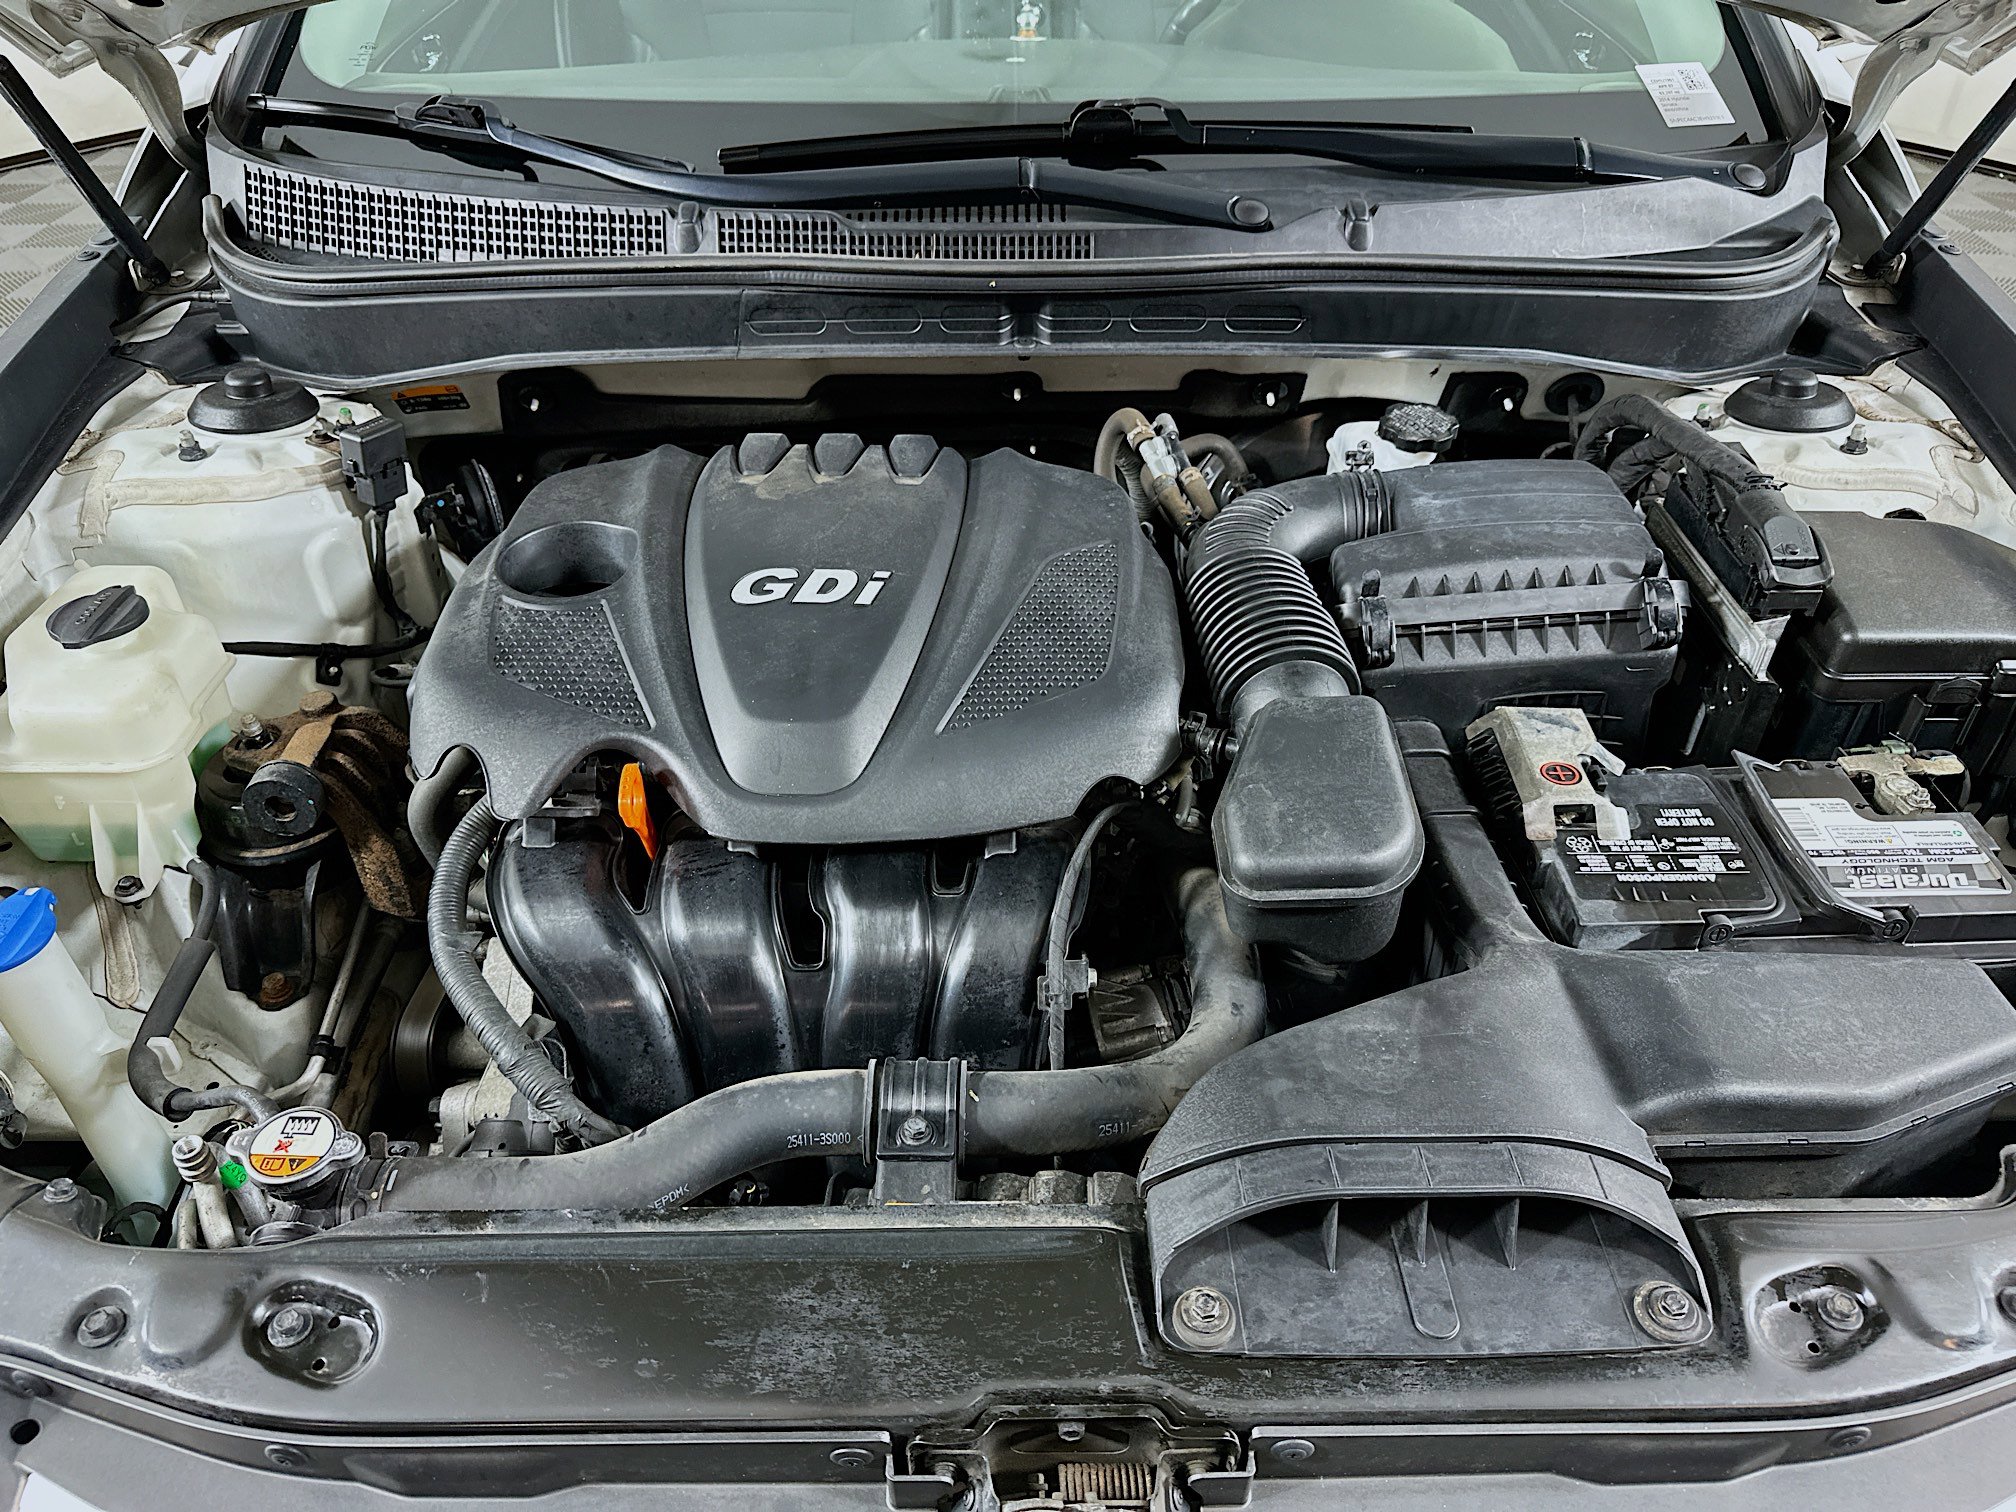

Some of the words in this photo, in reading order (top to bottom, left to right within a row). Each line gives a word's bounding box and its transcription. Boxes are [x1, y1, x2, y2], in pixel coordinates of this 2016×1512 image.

[730, 568, 893, 605] GDi
[1659, 808, 1703, 817] BATTERY!
[1655, 817, 1681, 826] OPEN
[1681, 817, 1700, 826] NOT
[1699, 817, 1715, 826] DO
[1844, 865, 1918, 873] PLATINUM
[1846, 872, 1968, 889] Duralast
[787, 1132, 851, 1148] 25411-3S000
